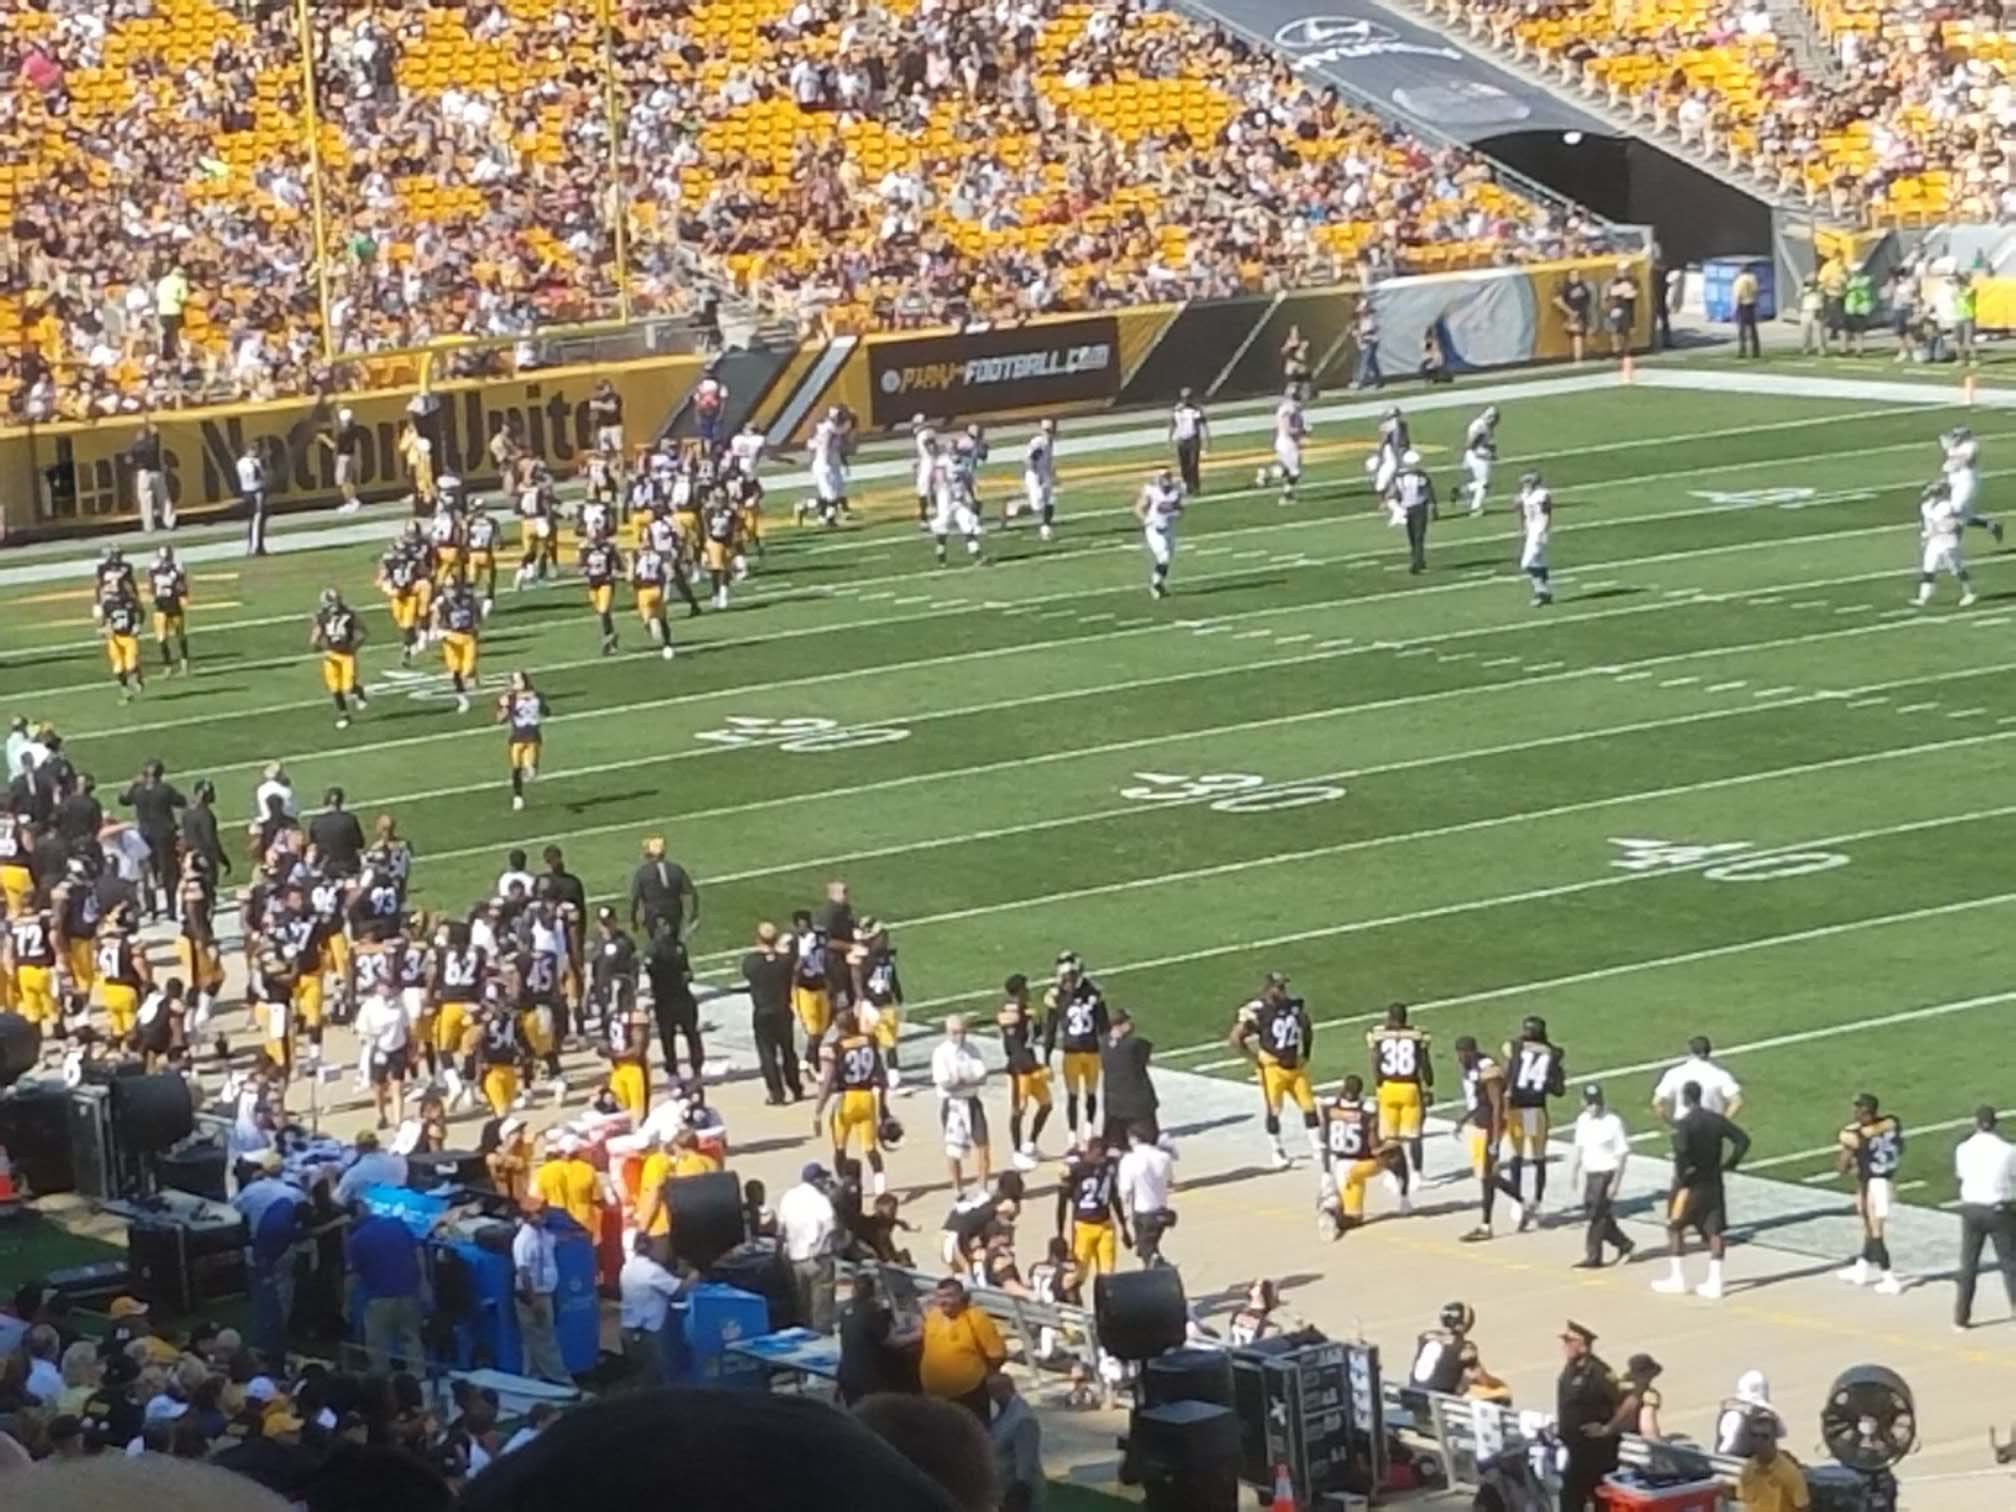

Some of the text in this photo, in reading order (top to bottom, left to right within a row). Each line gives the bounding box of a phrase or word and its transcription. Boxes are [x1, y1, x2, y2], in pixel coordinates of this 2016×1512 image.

[12, 924, 46, 957] 72
[444, 950, 478, 985] 62
[1380, 1037, 1416, 1076] 38
[1517, 1050, 1550, 1091] 14
[1329, 1119, 1362, 1153] 85
